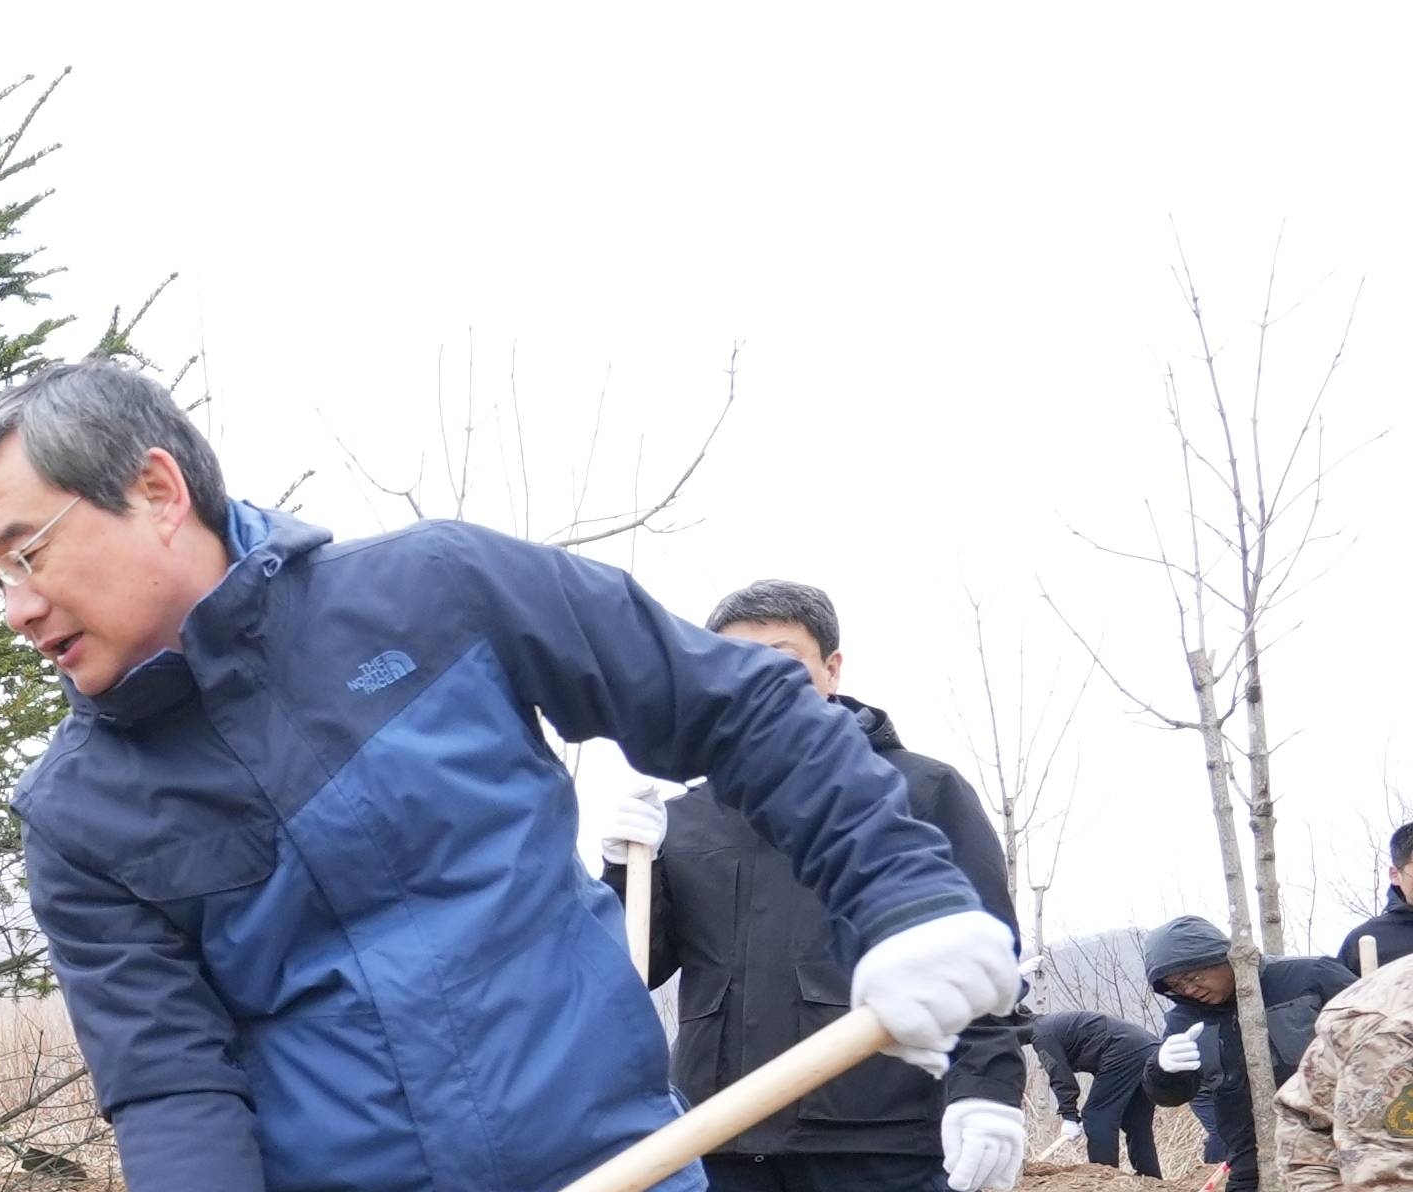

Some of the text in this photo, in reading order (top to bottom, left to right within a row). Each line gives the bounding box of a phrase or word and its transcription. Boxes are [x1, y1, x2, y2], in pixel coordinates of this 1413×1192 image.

[358, 657, 384, 674] THE
[346, 666, 392, 691] NORTH
[364, 677, 395, 695] FACE
